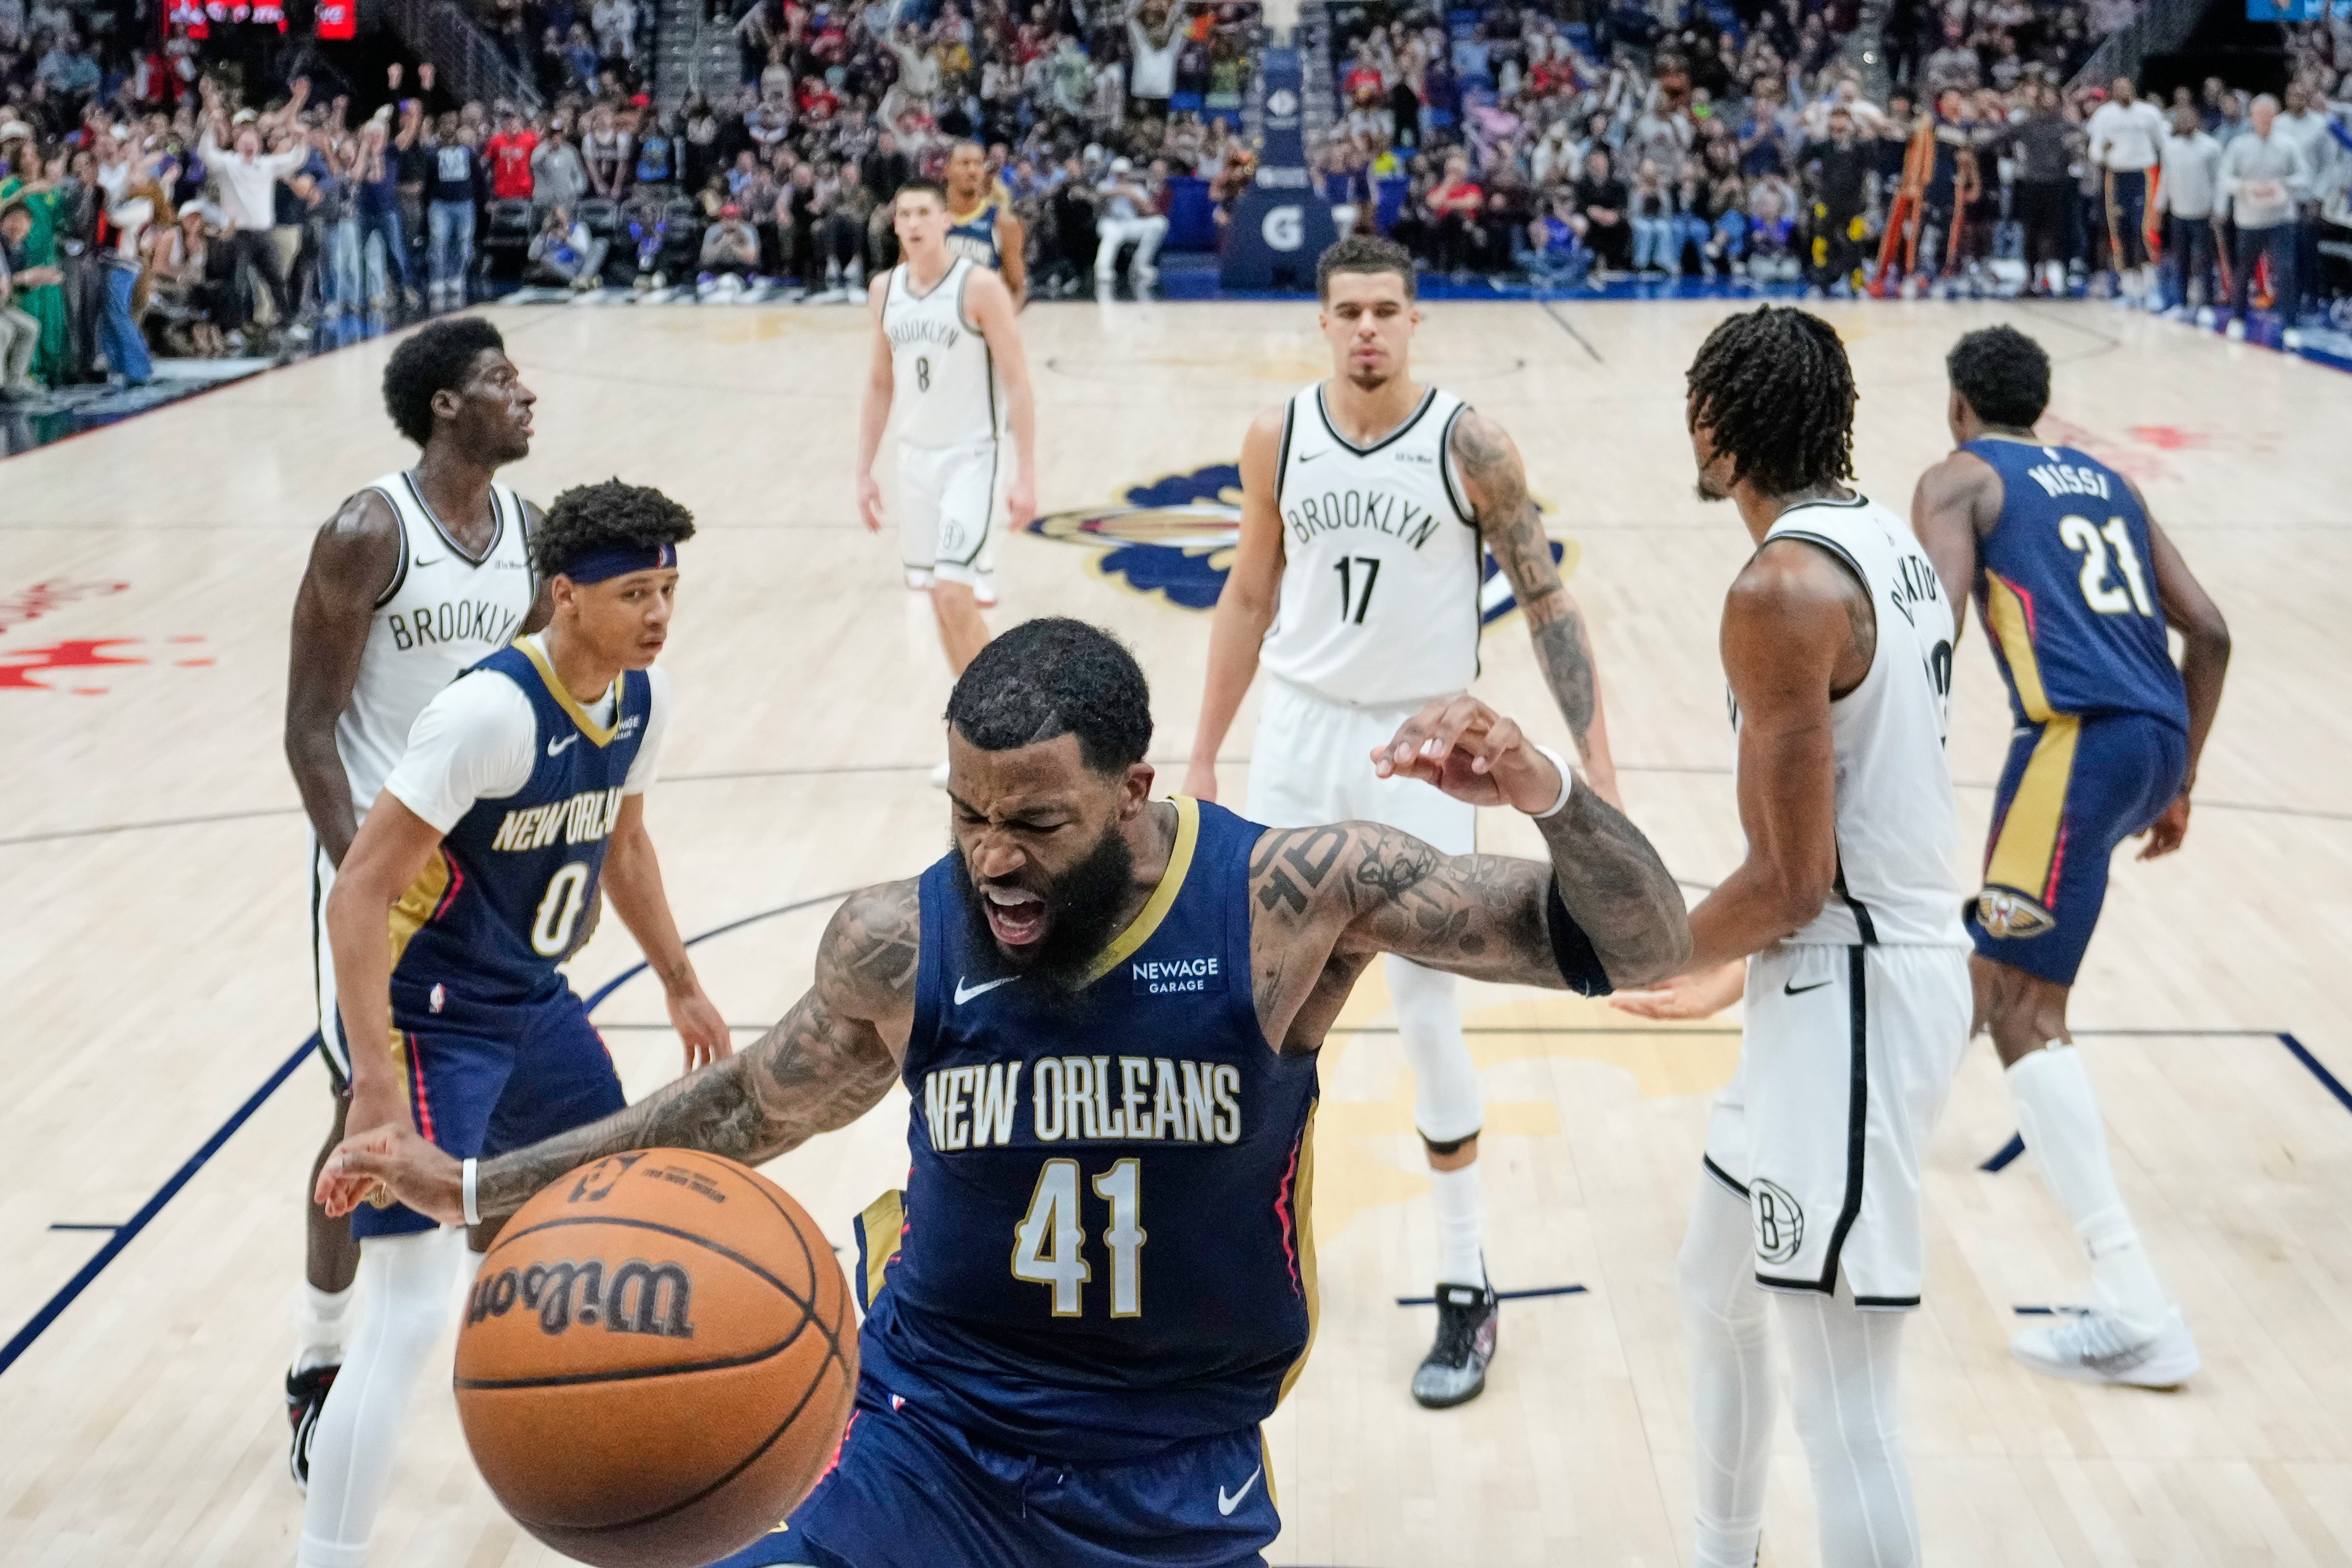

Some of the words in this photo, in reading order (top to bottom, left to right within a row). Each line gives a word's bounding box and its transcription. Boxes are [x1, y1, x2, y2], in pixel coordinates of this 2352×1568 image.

[1263, 206, 1304, 251] G
[916, 356, 929, 393] 8
[2027, 464, 2110, 499] MISSI
[1287, 491, 1440, 550] BROOKLYN
[1334, 556, 1381, 625] 17
[2059, 515, 2153, 616] 21
[619, 716, 640, 730] WAGE
[492, 800, 571, 851] NEW
[532, 862, 588, 956] 0
[1133, 958, 1218, 980] NEWAGE
[1149, 980, 1204, 993] GARAGE
[925, 1061, 1022, 1151] NEW
[1033, 1056, 1240, 1144] ORLEANS
[1011, 1158, 1147, 1318] 41
[1760, 1191, 1779, 1251] B
[466, 1258, 694, 1339] Wilson
